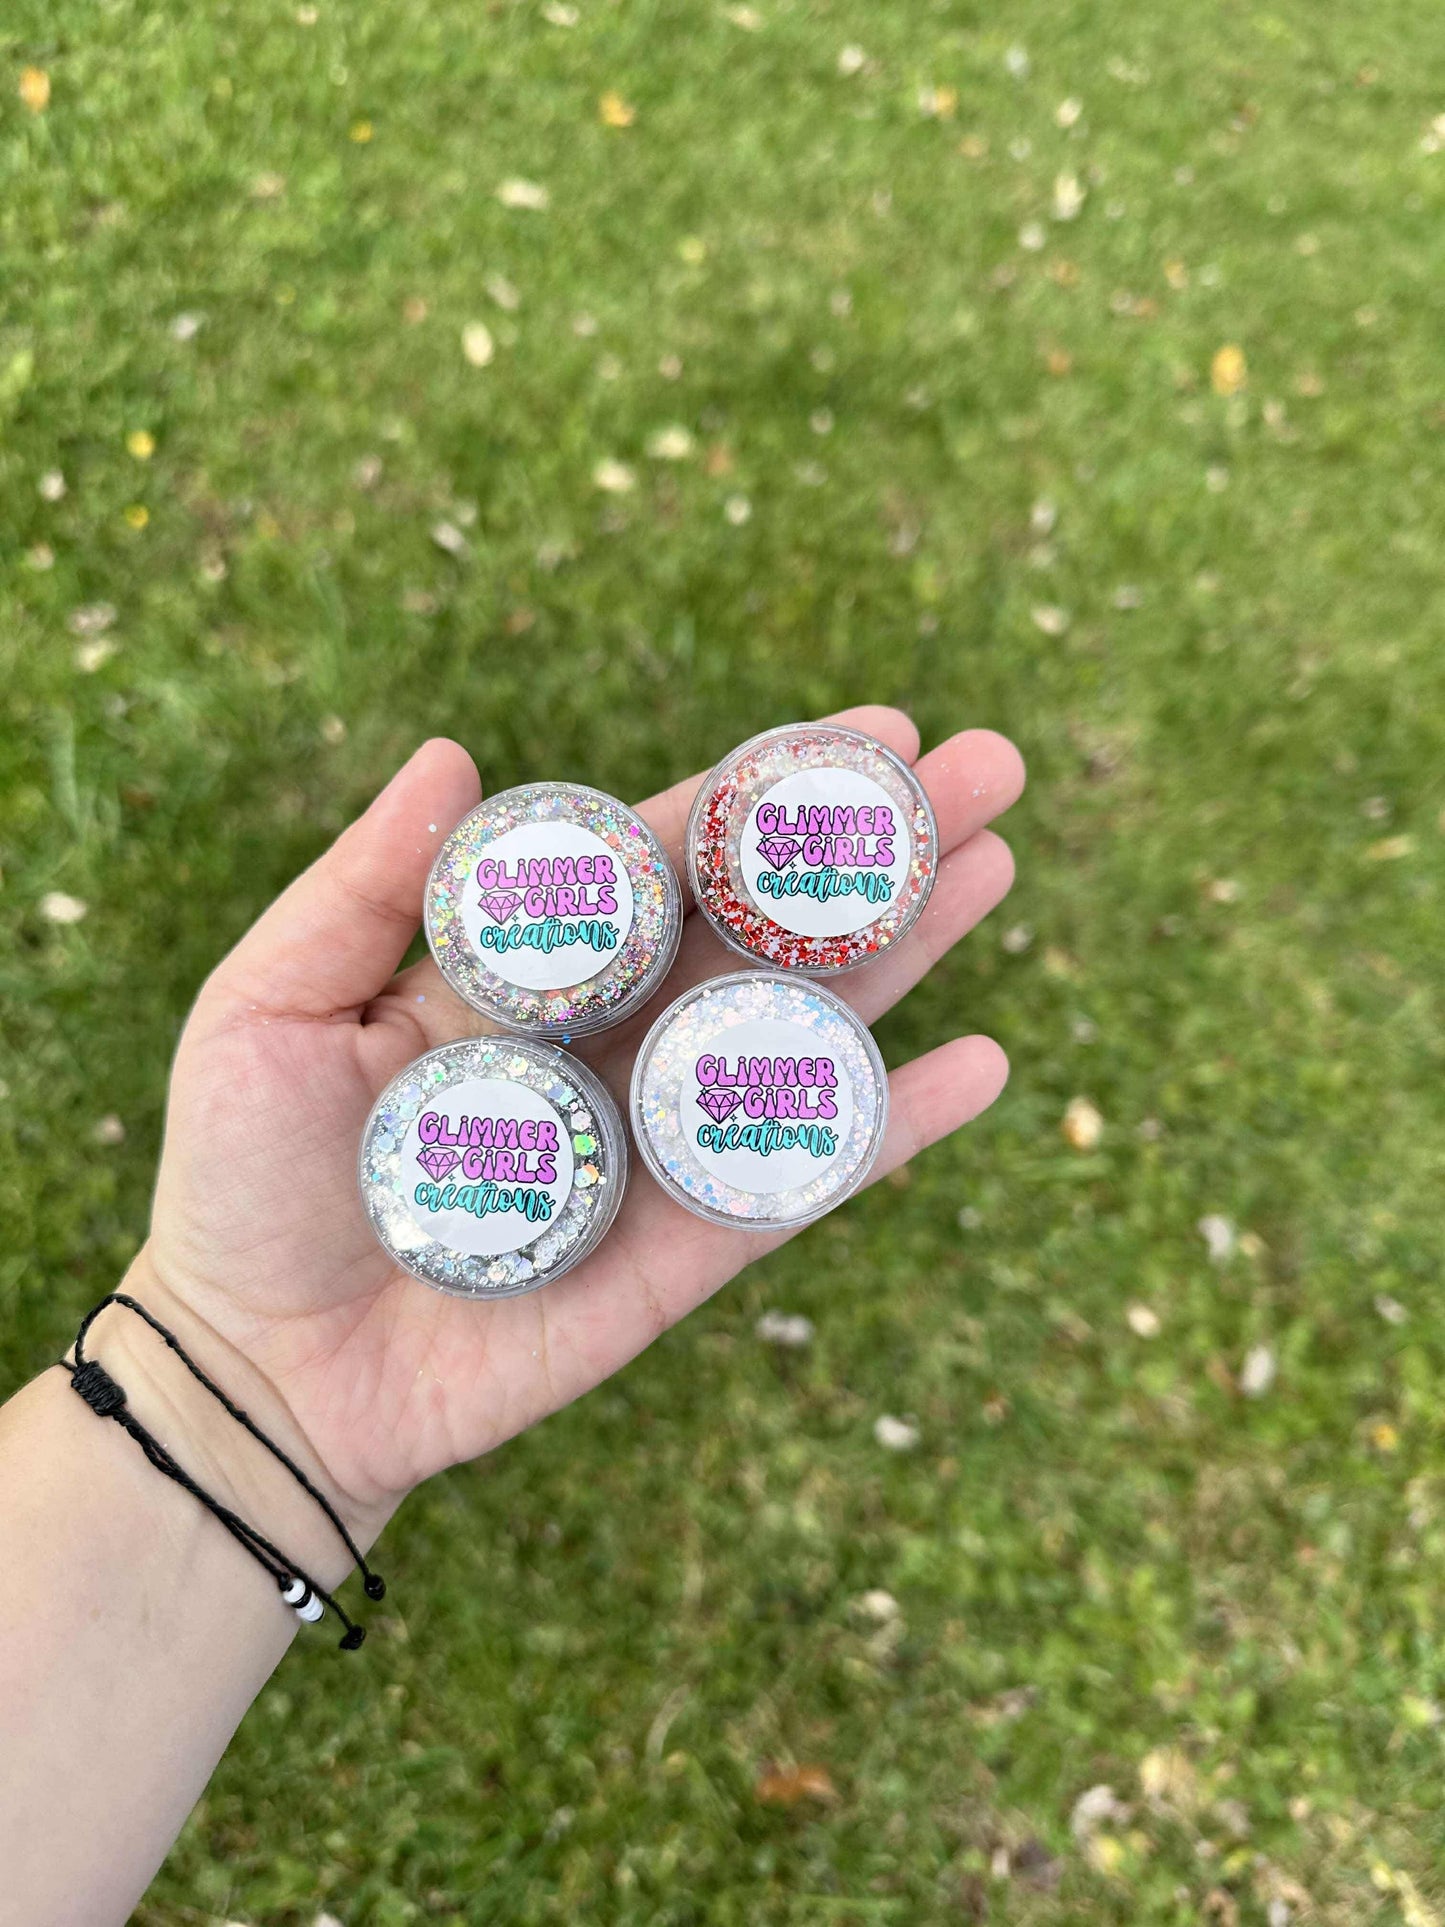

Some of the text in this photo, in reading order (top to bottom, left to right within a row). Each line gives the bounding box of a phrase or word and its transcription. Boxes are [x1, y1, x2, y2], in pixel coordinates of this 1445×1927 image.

[757, 866, 894, 903] creations
[480, 916, 618, 955] creations
[697, 1119, 839, 1157] creations
[414, 1179, 555, 1222] creations
